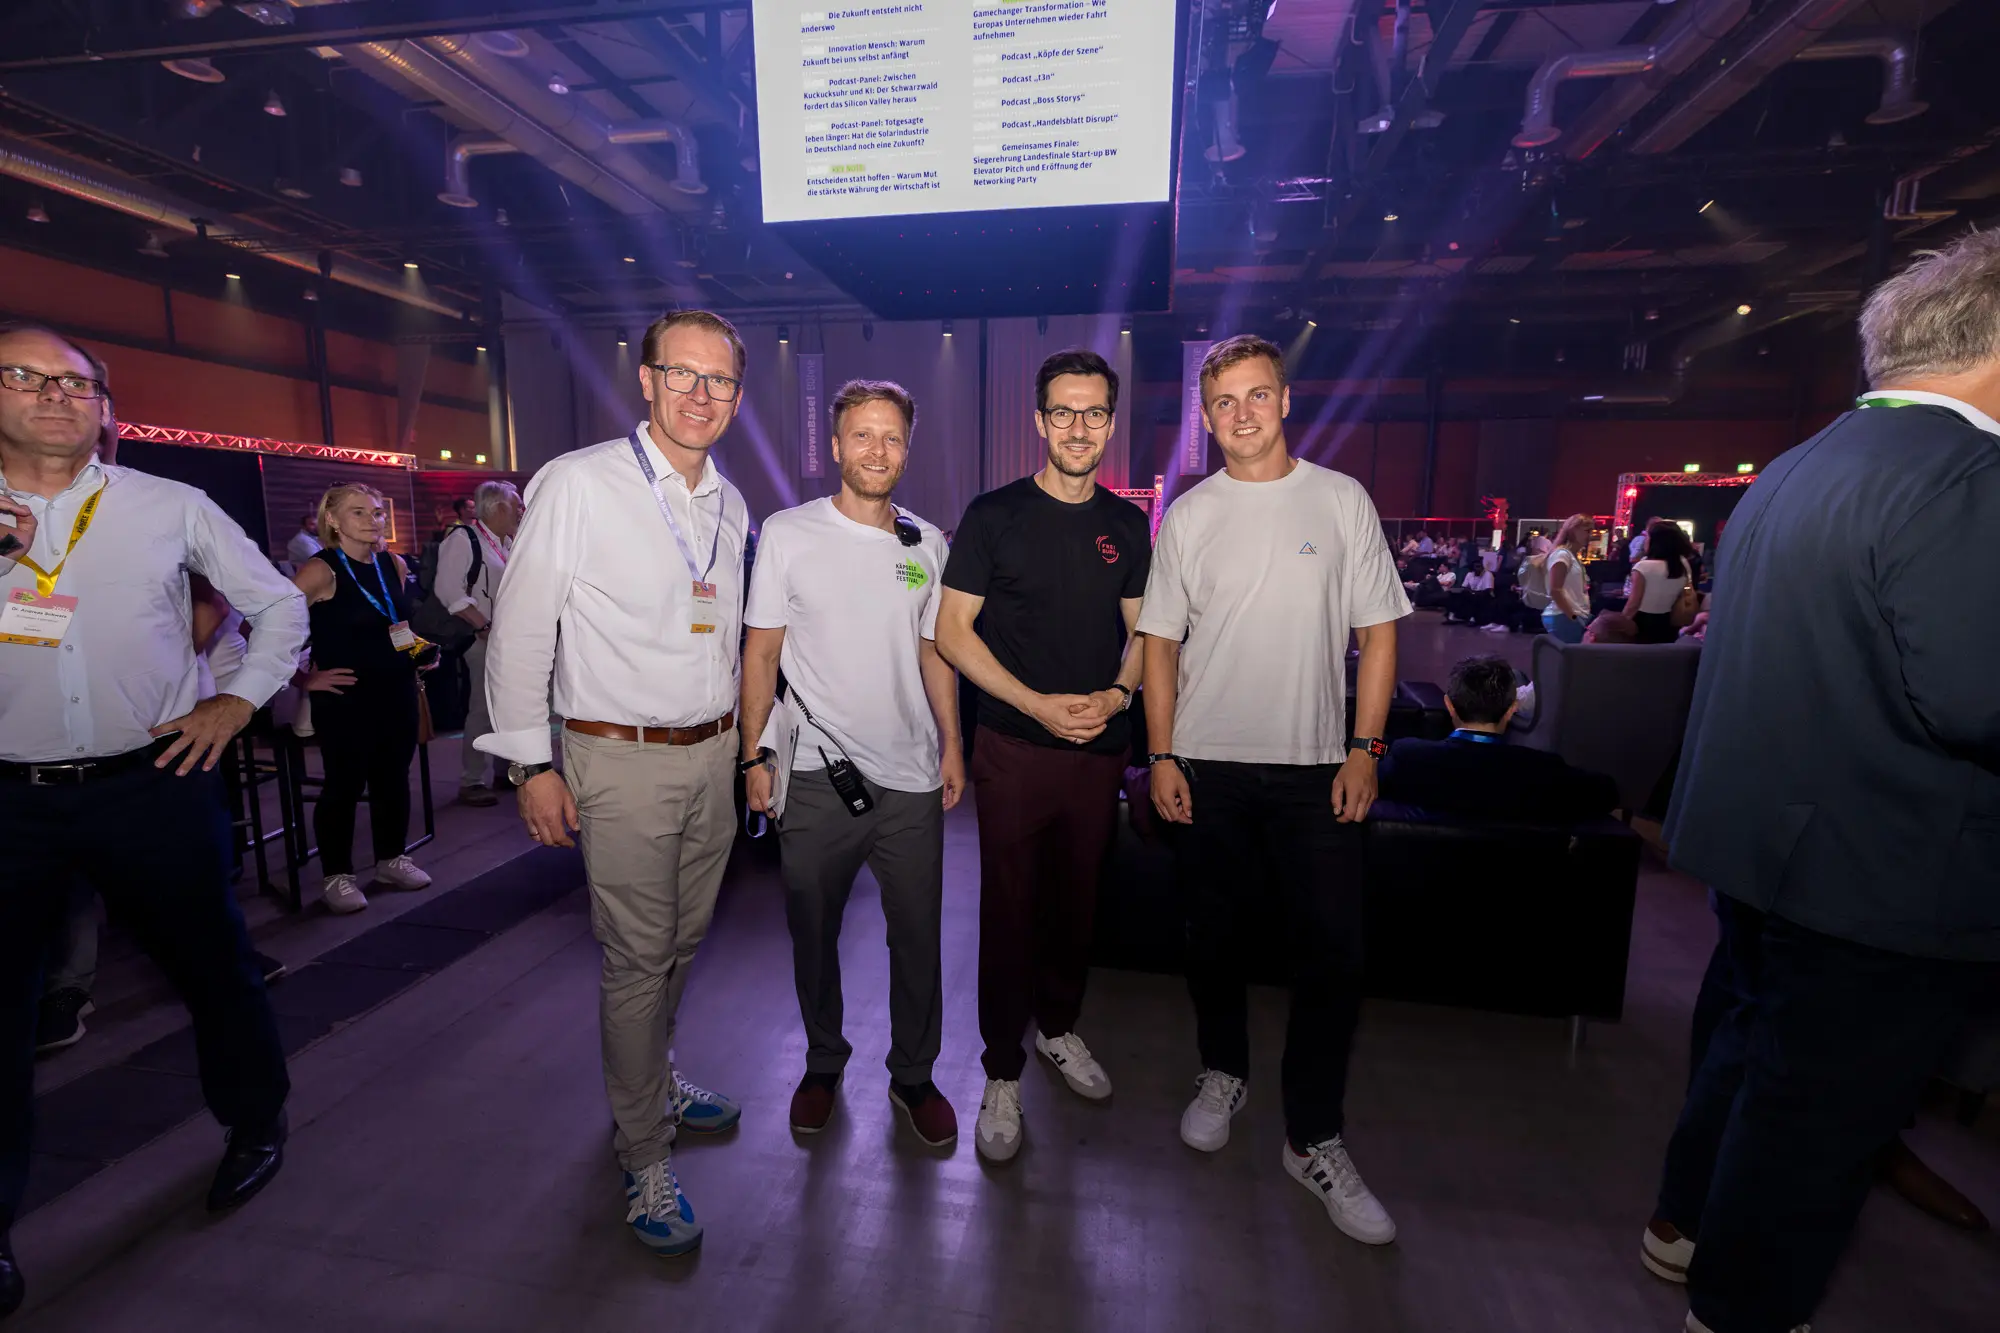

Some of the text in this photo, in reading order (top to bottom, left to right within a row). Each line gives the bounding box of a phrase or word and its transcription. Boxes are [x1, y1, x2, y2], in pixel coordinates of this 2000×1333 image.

[842, 9, 869, 18] Zukunft
[872, 6, 901, 15] entsteht
[904, 4, 922, 12] nicht
[973, 6, 1023, 18] Gamechanger
[1025, 1, 1084, 12] Transformation
[973, 10, 1107, 28] Europas Unternehmen wieder Fahrt
[801, 24, 835, 33] anderswo
[973, 30, 1015, 40] aufnehmen
[828, 44, 866, 53] Innovation
[869, 41, 897, 49] Mensch:
[803, 58, 829, 66] Zukunft
[858, 54, 879, 62] selbst
[881, 51, 909, 60] anfängt
[1002, 52, 1031, 60] Podcast
[829, 75, 881, 86] Podcast-Panel:
[883, 72, 916, 81] Zwischen
[1002, 75, 1032, 83] Podcast
[804, 89, 848, 99] Kuckucksuhr
[891, 82, 937, 92] Schwarzwald
[804, 102, 828, 110] fordert
[844, 99, 867, 108] Silicon
[869, 97, 891, 106] Valley
[893, 96, 917, 104] heraus
[1002, 98, 1030, 106] Podcast
[831, 119, 883, 130] Podcast-Panel:
[885, 116, 923, 126] Totgesagte
[1002, 120, 1031, 128] Podcast
[826, 133, 850, 142] länger:
[879, 127, 929, 137] Solarindustrie
[814, 143, 856, 152] Deutschland
[893, 139, 924, 147] Zukunft?
[1002, 142, 1052, 151] Gemeinsames
[974, 154, 1021, 164] Siegerehrung
[1023, 151, 1070, 161] Landesfinale
[1072, 149, 1103, 158] Start-up
[1005, 164, 1024, 172] Pitch
[1042, 161, 1078, 171] Eröffnung
[807, 176, 848, 185] Entscheiden
[868, 173, 890, 181] hoffen
[974, 175, 1036, 186] Networking Party
[819, 185, 846, 195] stärkste
[848, 184, 878, 194] Währung
[880, 183, 892, 191] der
[894, 181, 929, 190] Wirtschaft
[1188, 386, 1200, 468] uptownBasel
[806, 396, 818, 472] uptownBasel
[896, 576, 918, 584] FESTIVAL
